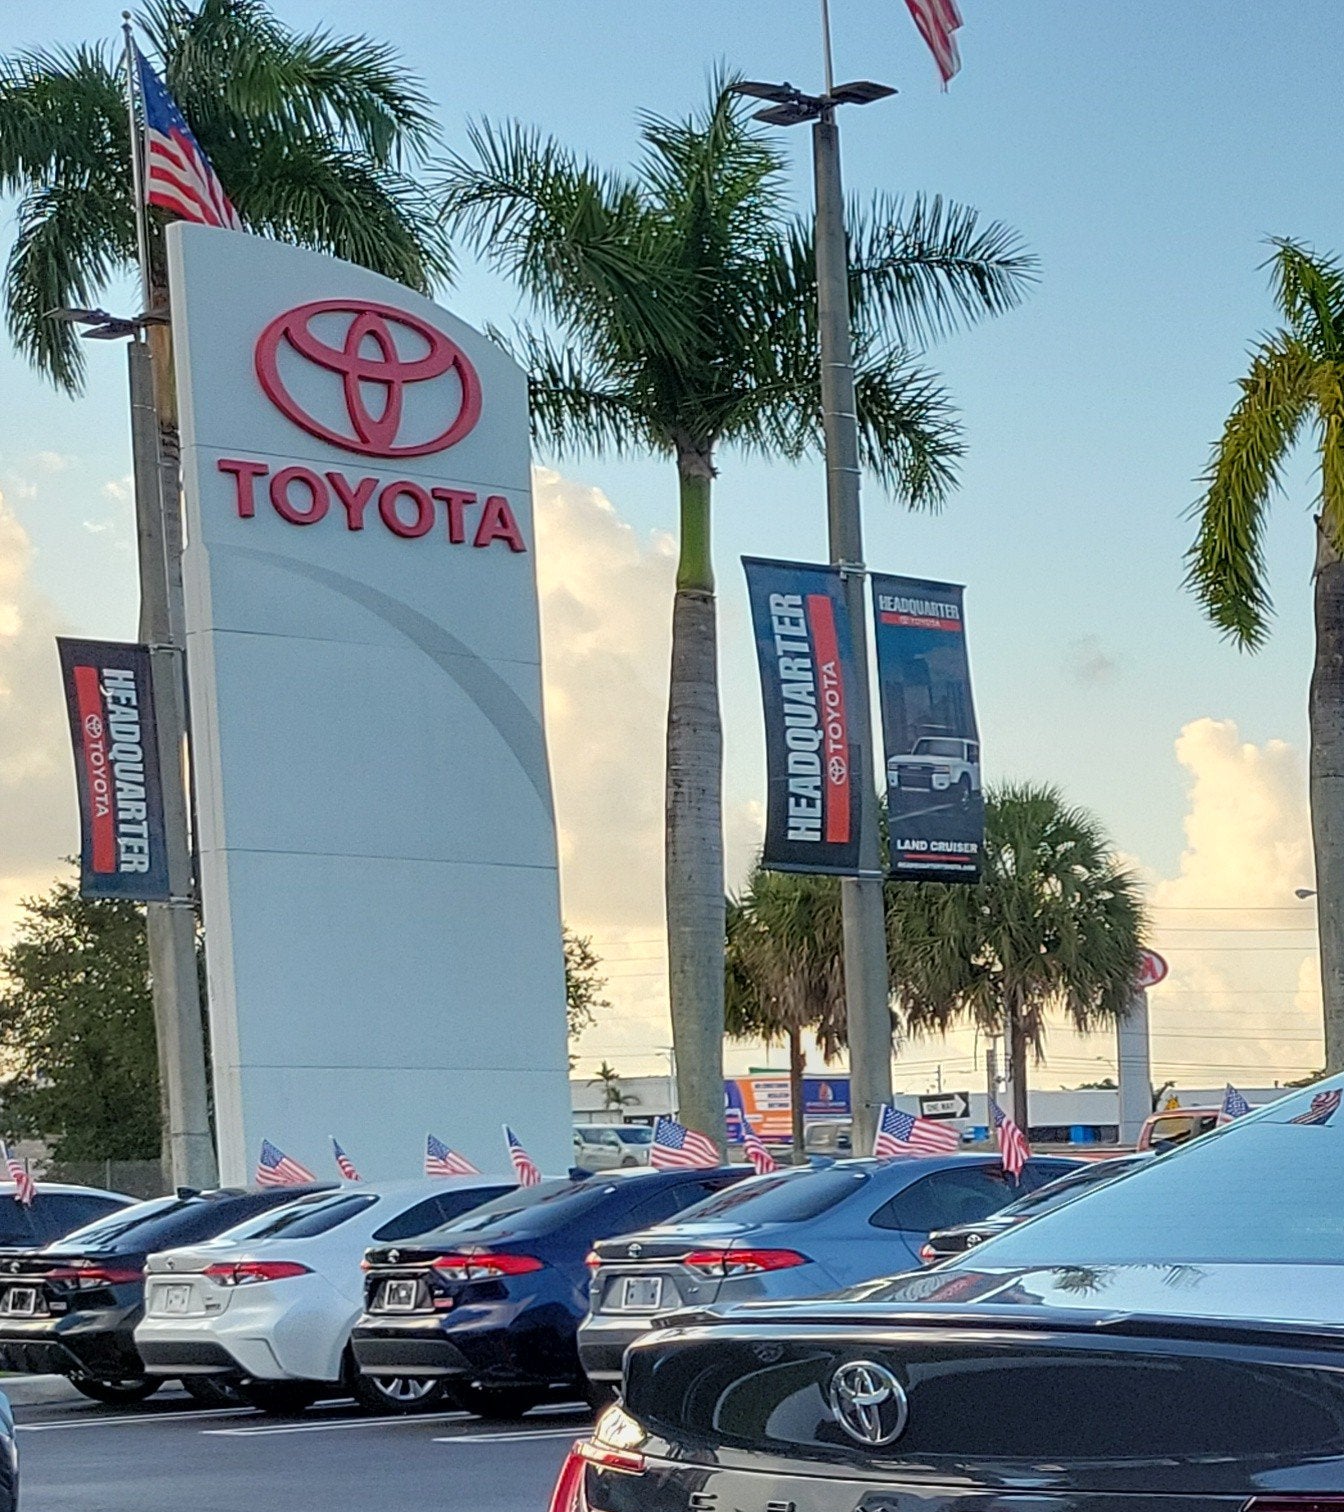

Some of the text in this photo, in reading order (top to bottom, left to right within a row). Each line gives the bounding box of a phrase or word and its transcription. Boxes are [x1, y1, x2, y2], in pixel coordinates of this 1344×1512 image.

[217, 457, 527, 554] TOYOTA
[878, 594, 960, 620] HEADQUARTER
[768, 593, 822, 843] HEADQUARTER
[823, 660, 849, 753] TOYOTA
[90, 741, 109, 817] TOYOTA
[102, 669, 150, 874] HEADQUARTER
[897, 839, 978, 854] LAND CRUISER
